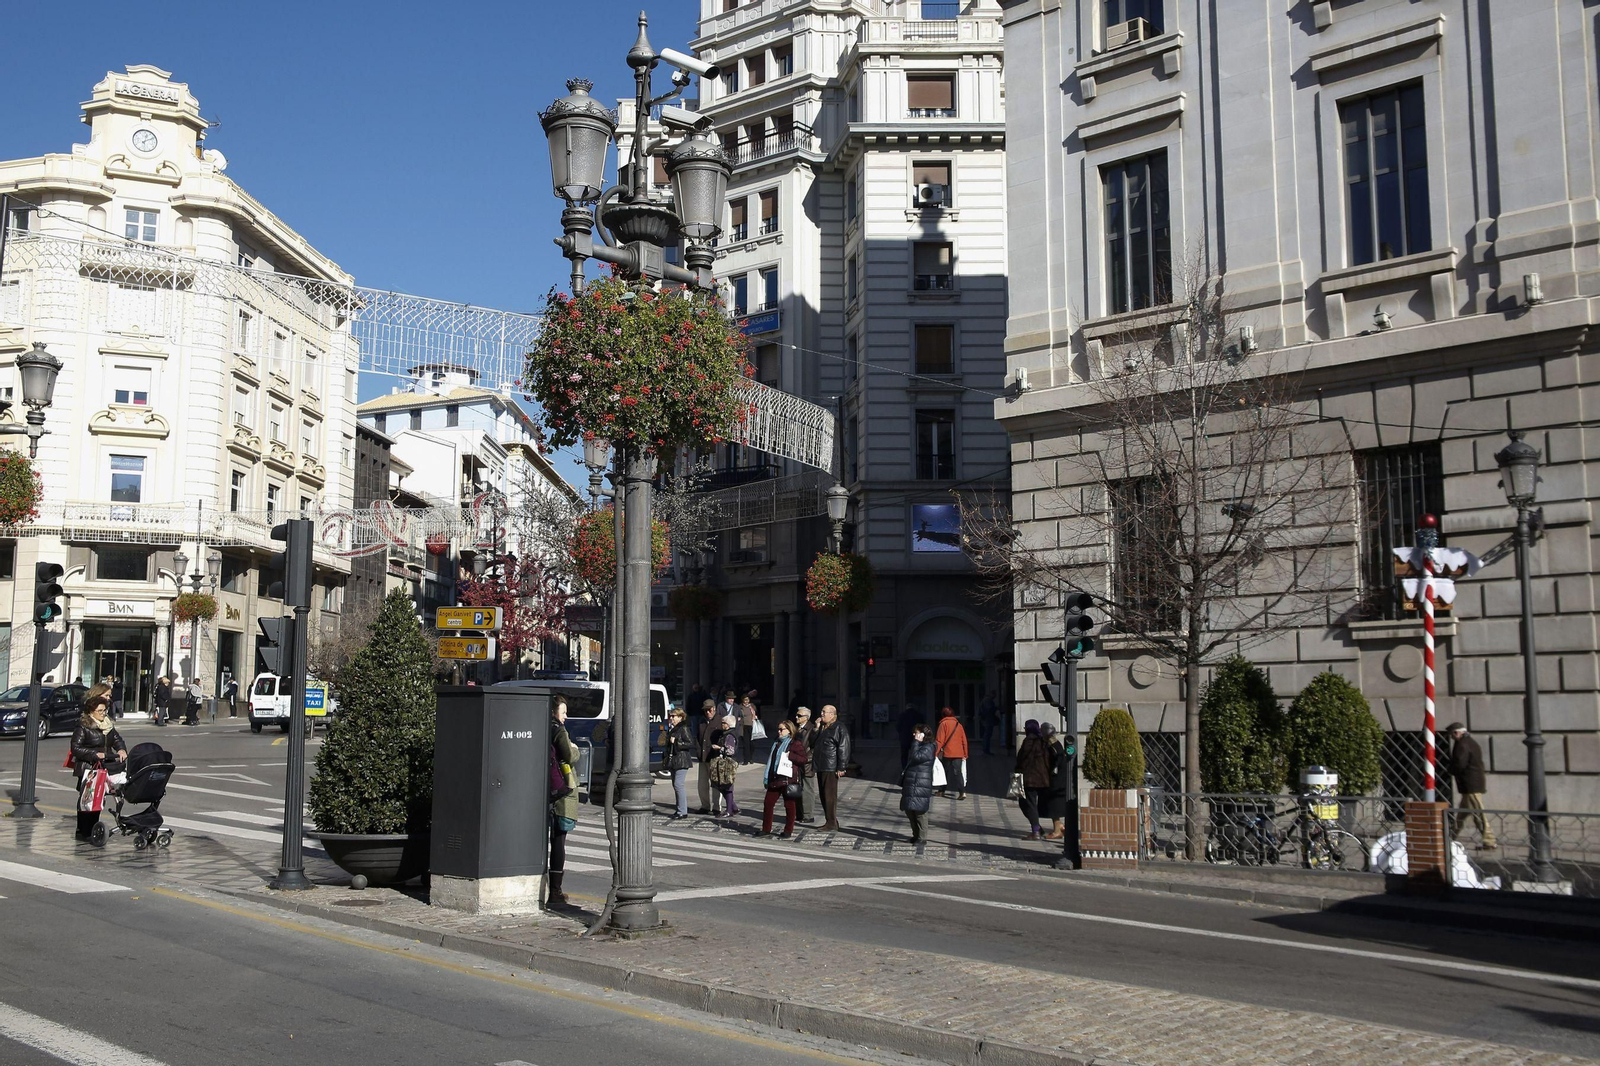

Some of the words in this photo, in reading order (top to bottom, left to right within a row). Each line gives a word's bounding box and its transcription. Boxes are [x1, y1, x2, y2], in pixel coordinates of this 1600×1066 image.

[130, 85, 179, 101] GENERAL
[108, 602, 135, 614] BMN
[225, 603, 241, 621] BMN
[440, 640, 456, 648] Oficina
[440, 648, 458, 656] Turismo
[648, 714, 662, 723] CIA
